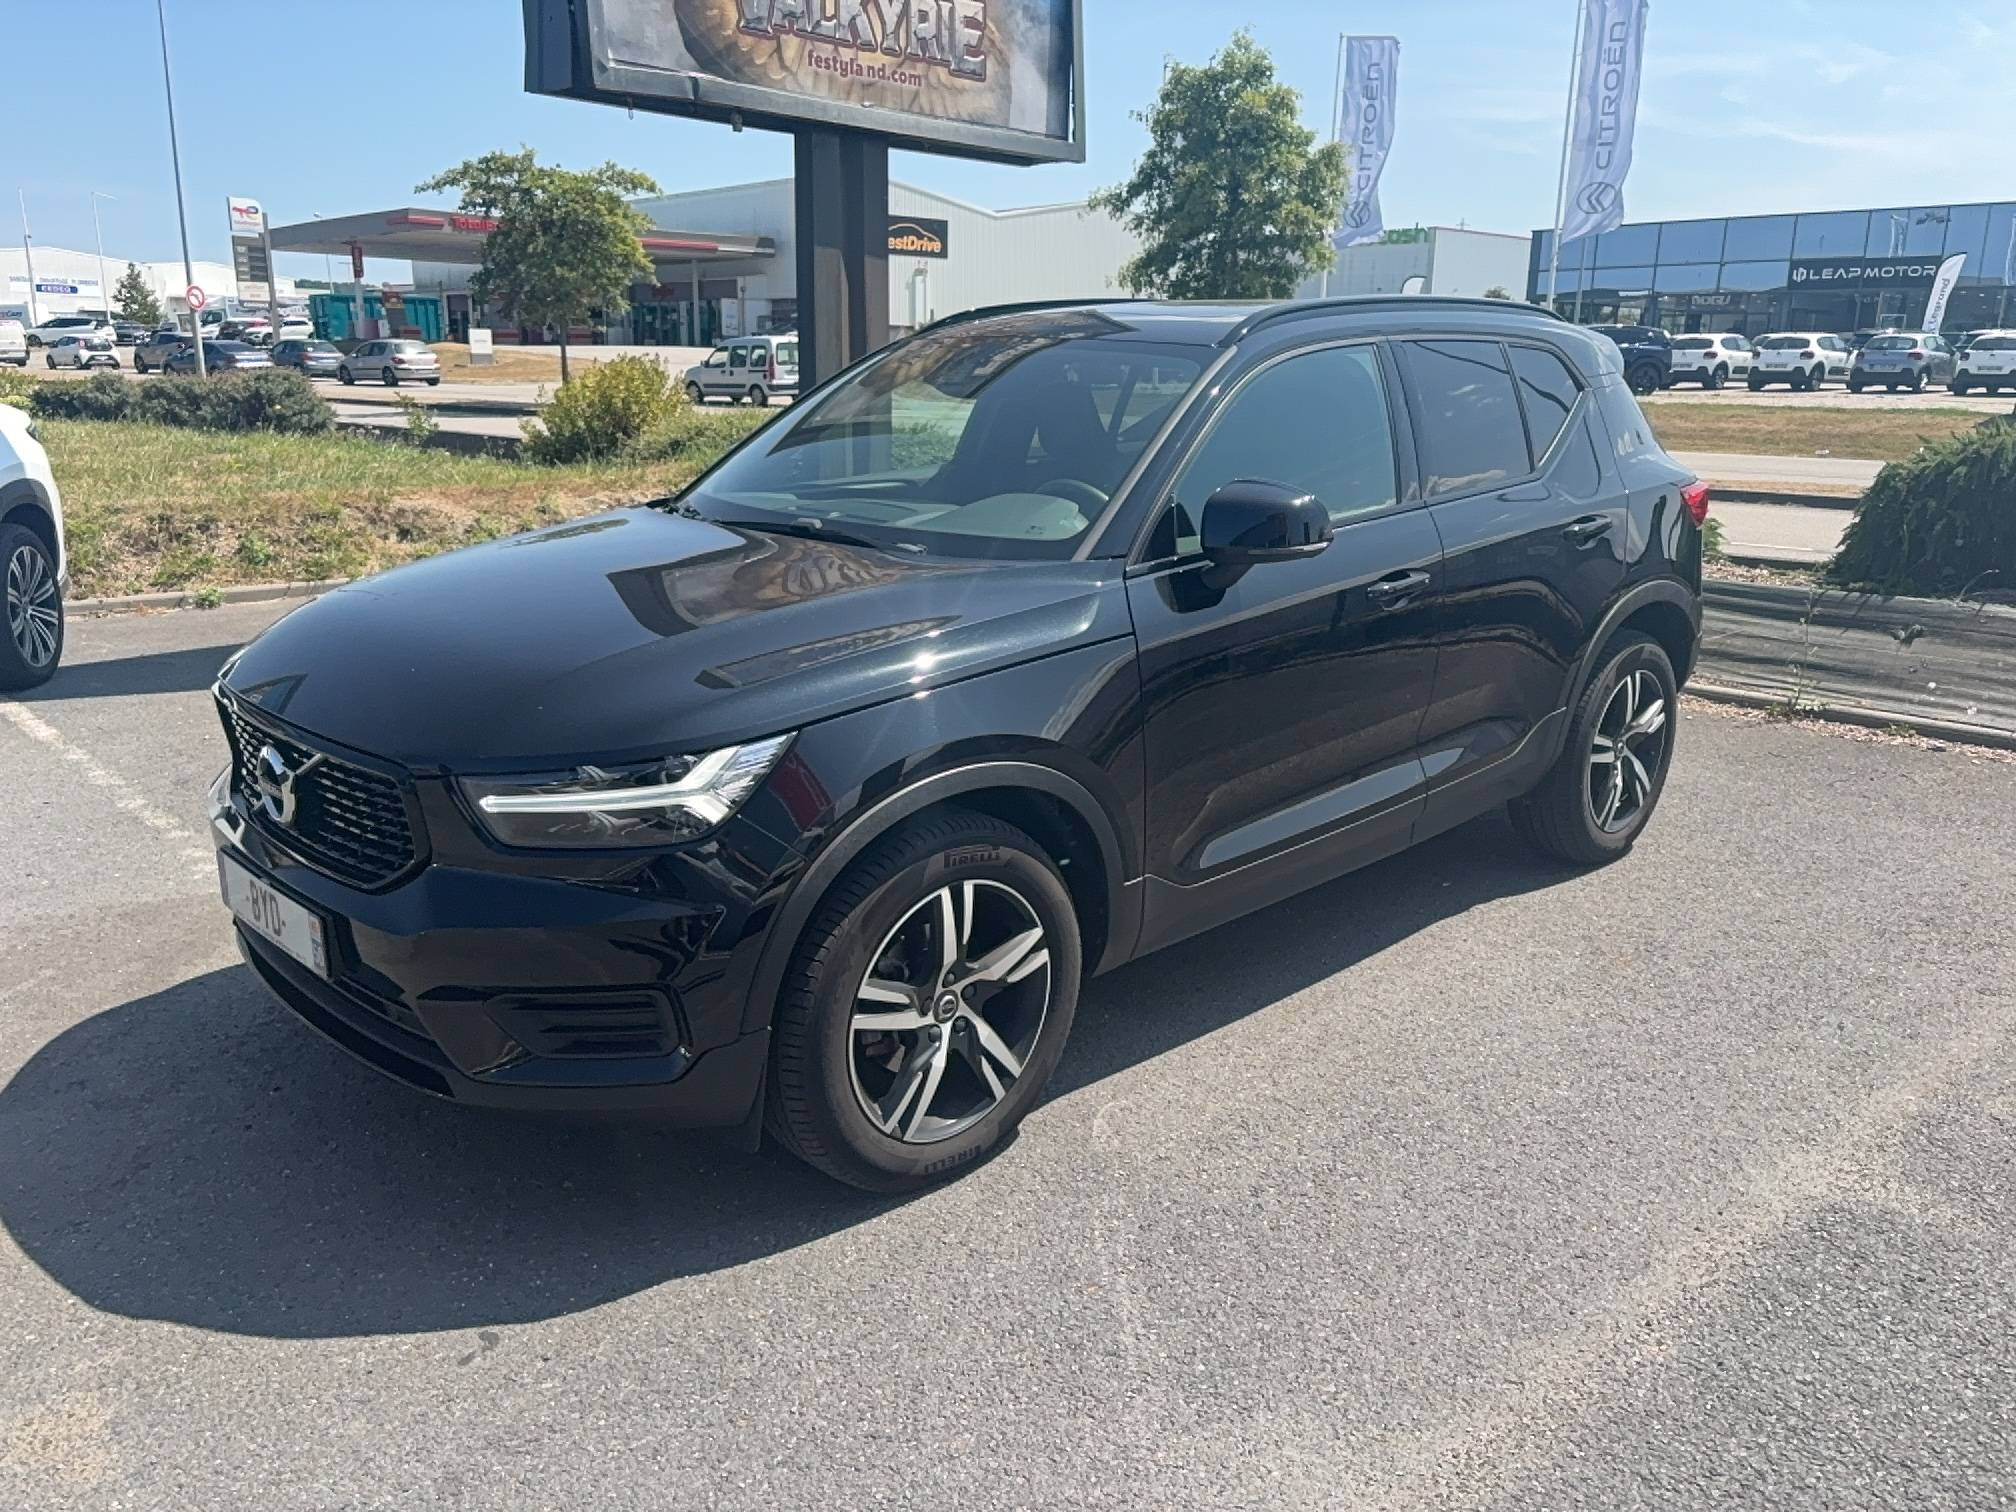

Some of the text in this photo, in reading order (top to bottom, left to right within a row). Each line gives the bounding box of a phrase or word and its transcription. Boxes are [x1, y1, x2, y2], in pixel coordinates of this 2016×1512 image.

[808, 50, 922, 87] festyland.com
[888, 235, 942, 253] estDrive
[944, 846, 1001, 869] PIRELLI
